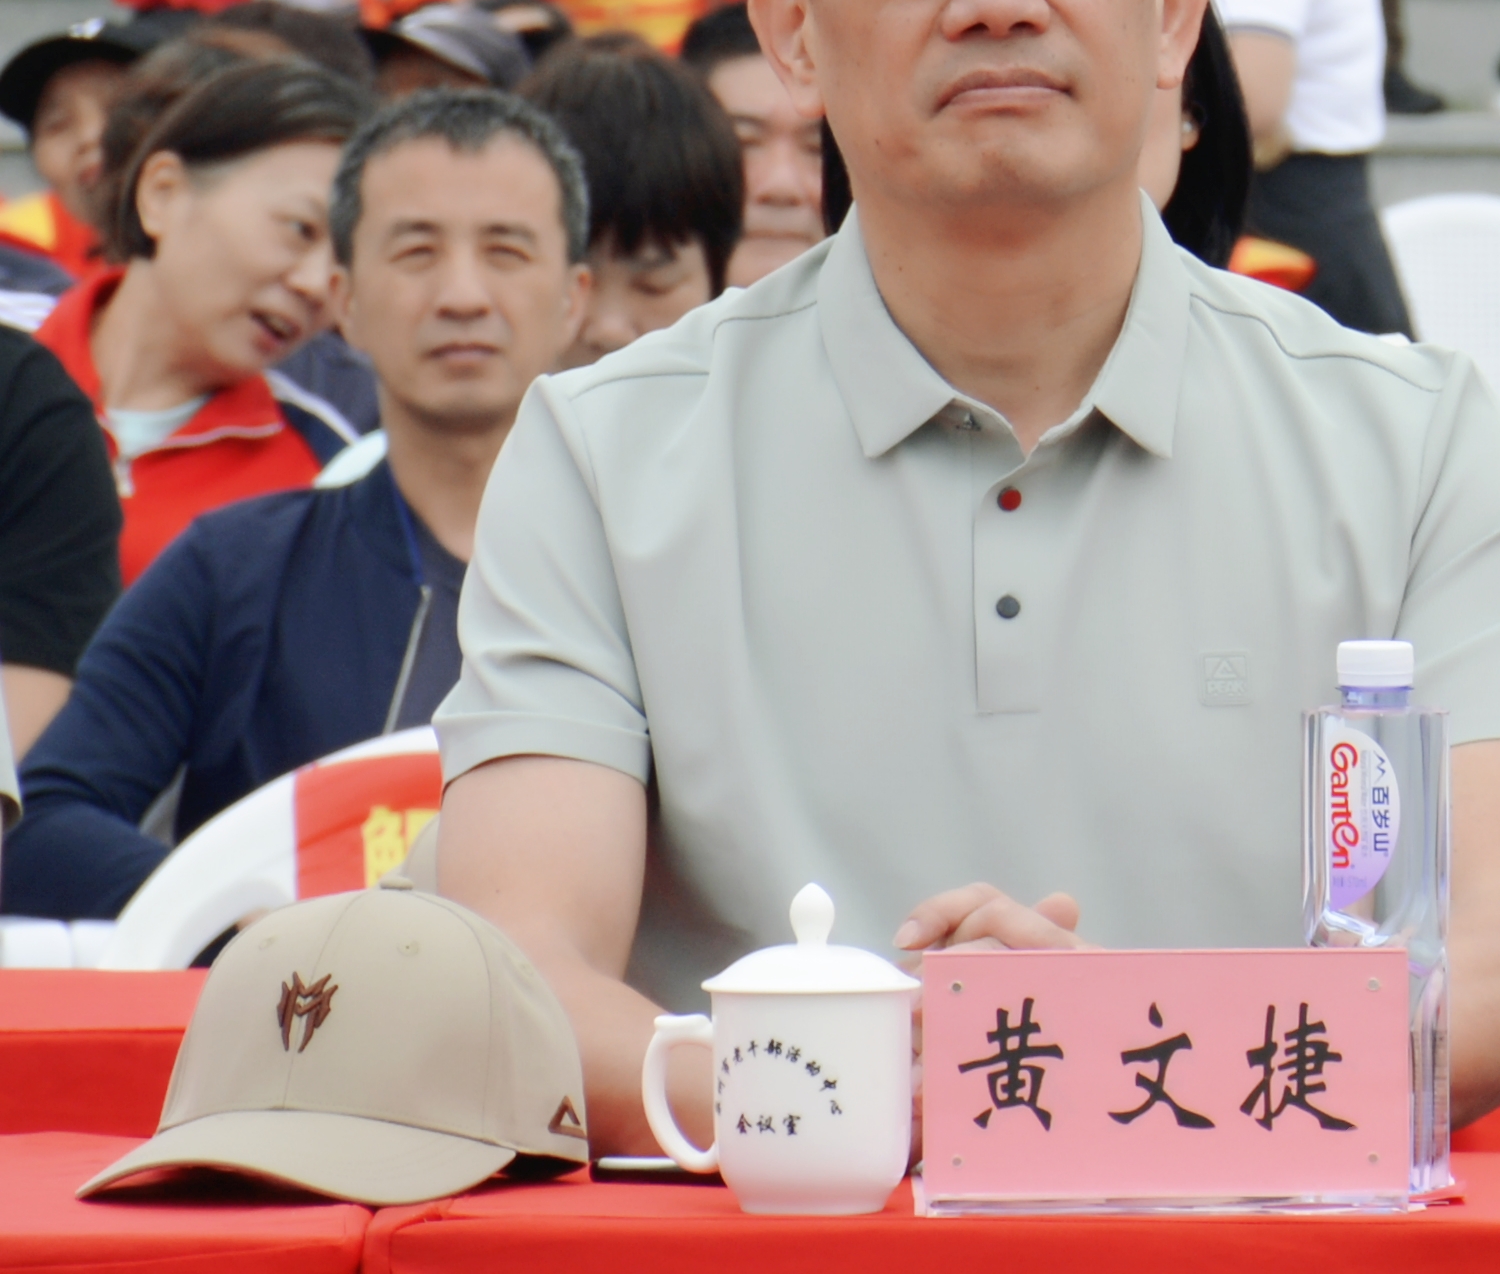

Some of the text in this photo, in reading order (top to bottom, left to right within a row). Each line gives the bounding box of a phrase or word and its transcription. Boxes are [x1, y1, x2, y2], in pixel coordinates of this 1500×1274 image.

[1206, 679, 1246, 694] PEAK
[1330, 742, 1359, 870] Ganten
[1372, 786, 1391, 853] 百岁山
[957, 997, 1356, 1132] 黄文捷
[736, 1112, 802, 1136] 会议室
